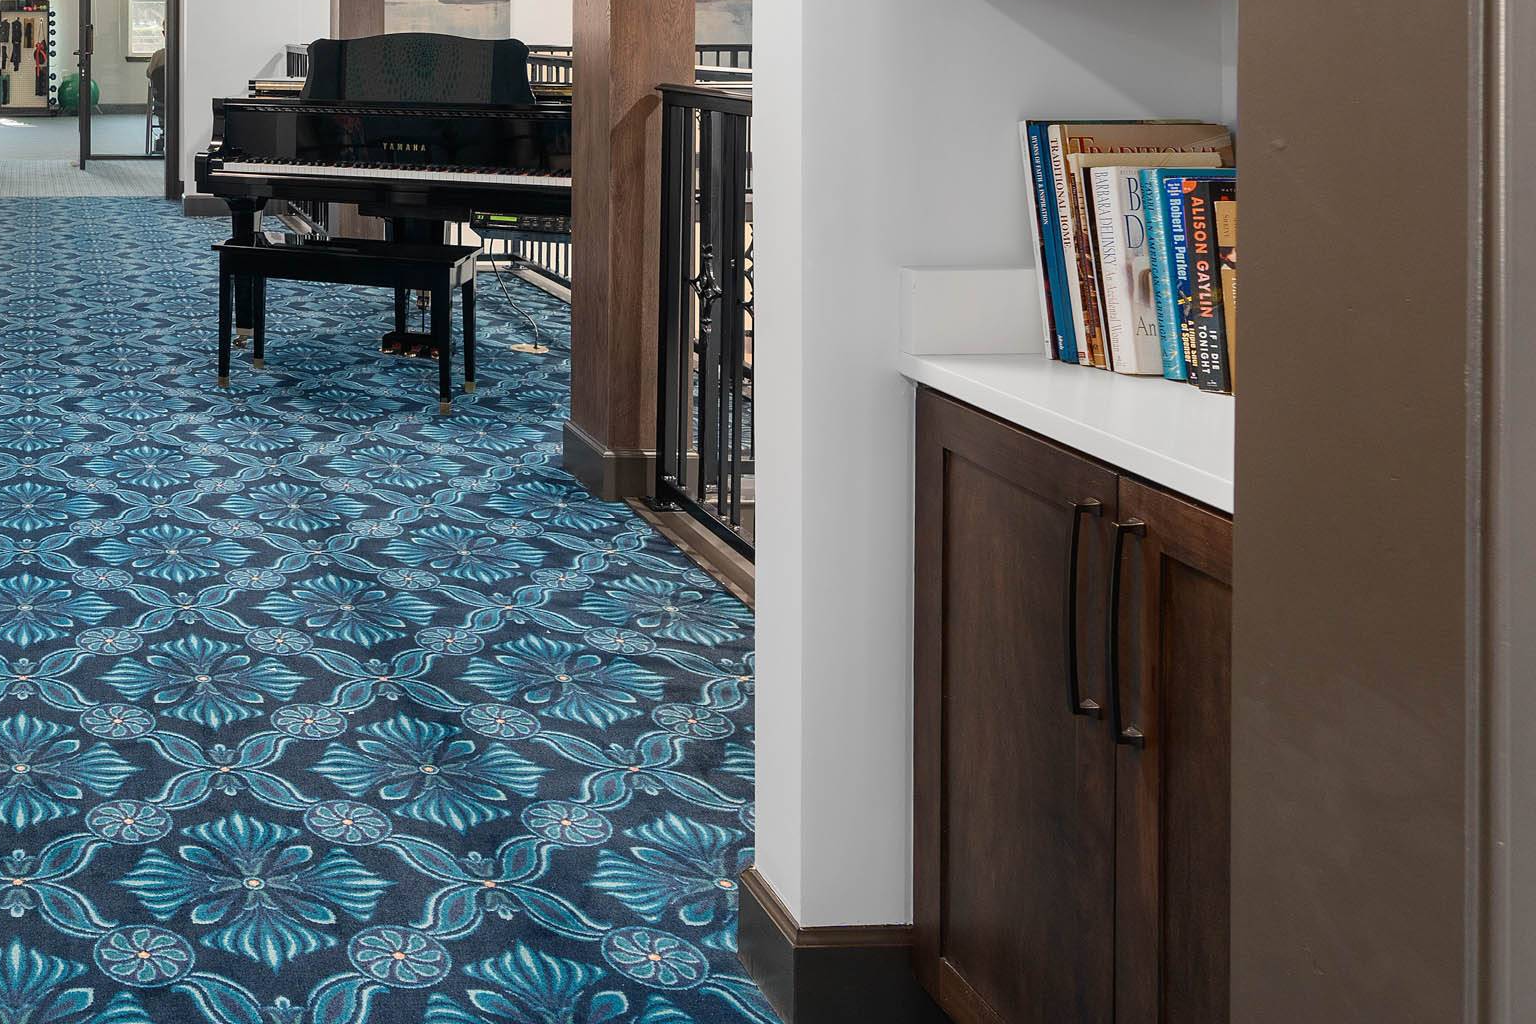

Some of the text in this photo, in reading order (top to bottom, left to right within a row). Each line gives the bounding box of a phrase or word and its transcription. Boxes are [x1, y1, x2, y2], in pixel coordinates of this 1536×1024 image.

[383, 142, 426, 152] YAMAHA
[1031, 135, 1040, 155] HYMNS
[1035, 164, 1044, 182] FAITH
[1039, 189, 1049, 225] INSPIRATION
[1050, 137, 1072, 249] TRADITIONAL HOME
[1095, 171, 1113, 216] BARBARA
[1169, 198, 1184, 232] Robert
[1100, 217, 1117, 266] DELINSKY
[1173, 234, 1185, 245] B.
[1175, 246, 1188, 281] Parker
[1191, 196, 1214, 318] ALISON GAYLIN
[1148, 237, 1160, 286] AMERICAN
[1155, 291, 1167, 341] MARRIAGE
[1182, 332, 1191, 363] Spenser
[1198, 325, 1210, 374] TONIGHT
[1209, 330, 1217, 341] IF
[1210, 354, 1220, 370] DIE
